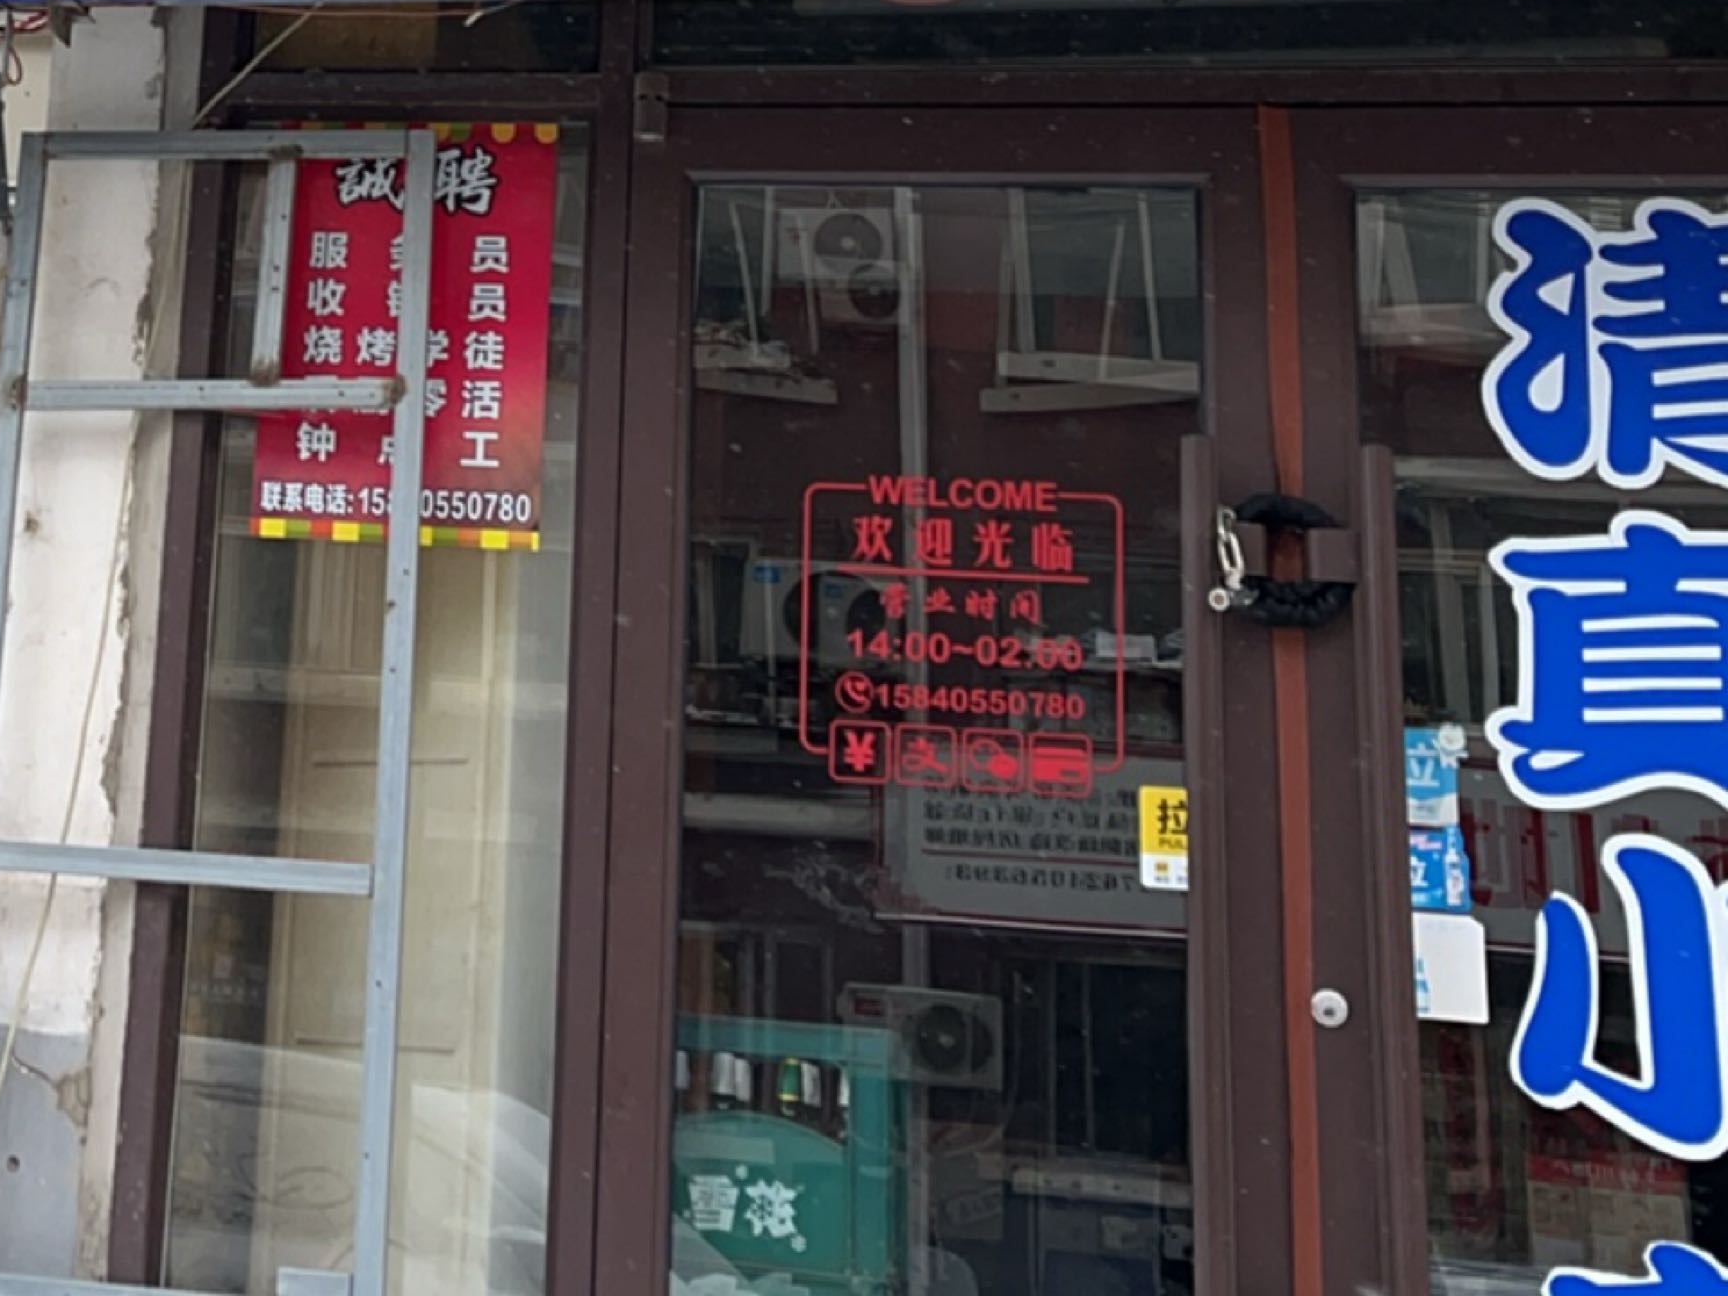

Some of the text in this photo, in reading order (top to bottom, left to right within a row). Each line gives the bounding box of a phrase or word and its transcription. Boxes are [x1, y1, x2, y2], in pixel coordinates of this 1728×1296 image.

[260, 481, 532, 522] 联系电话:150550780
[869, 474, 1058, 512] WELCOME
[852, 515, 1074, 572] 欢迎光临
[880, 581, 1041, 625] 营业时间
[874, 683, 1085, 721] 15840550780
